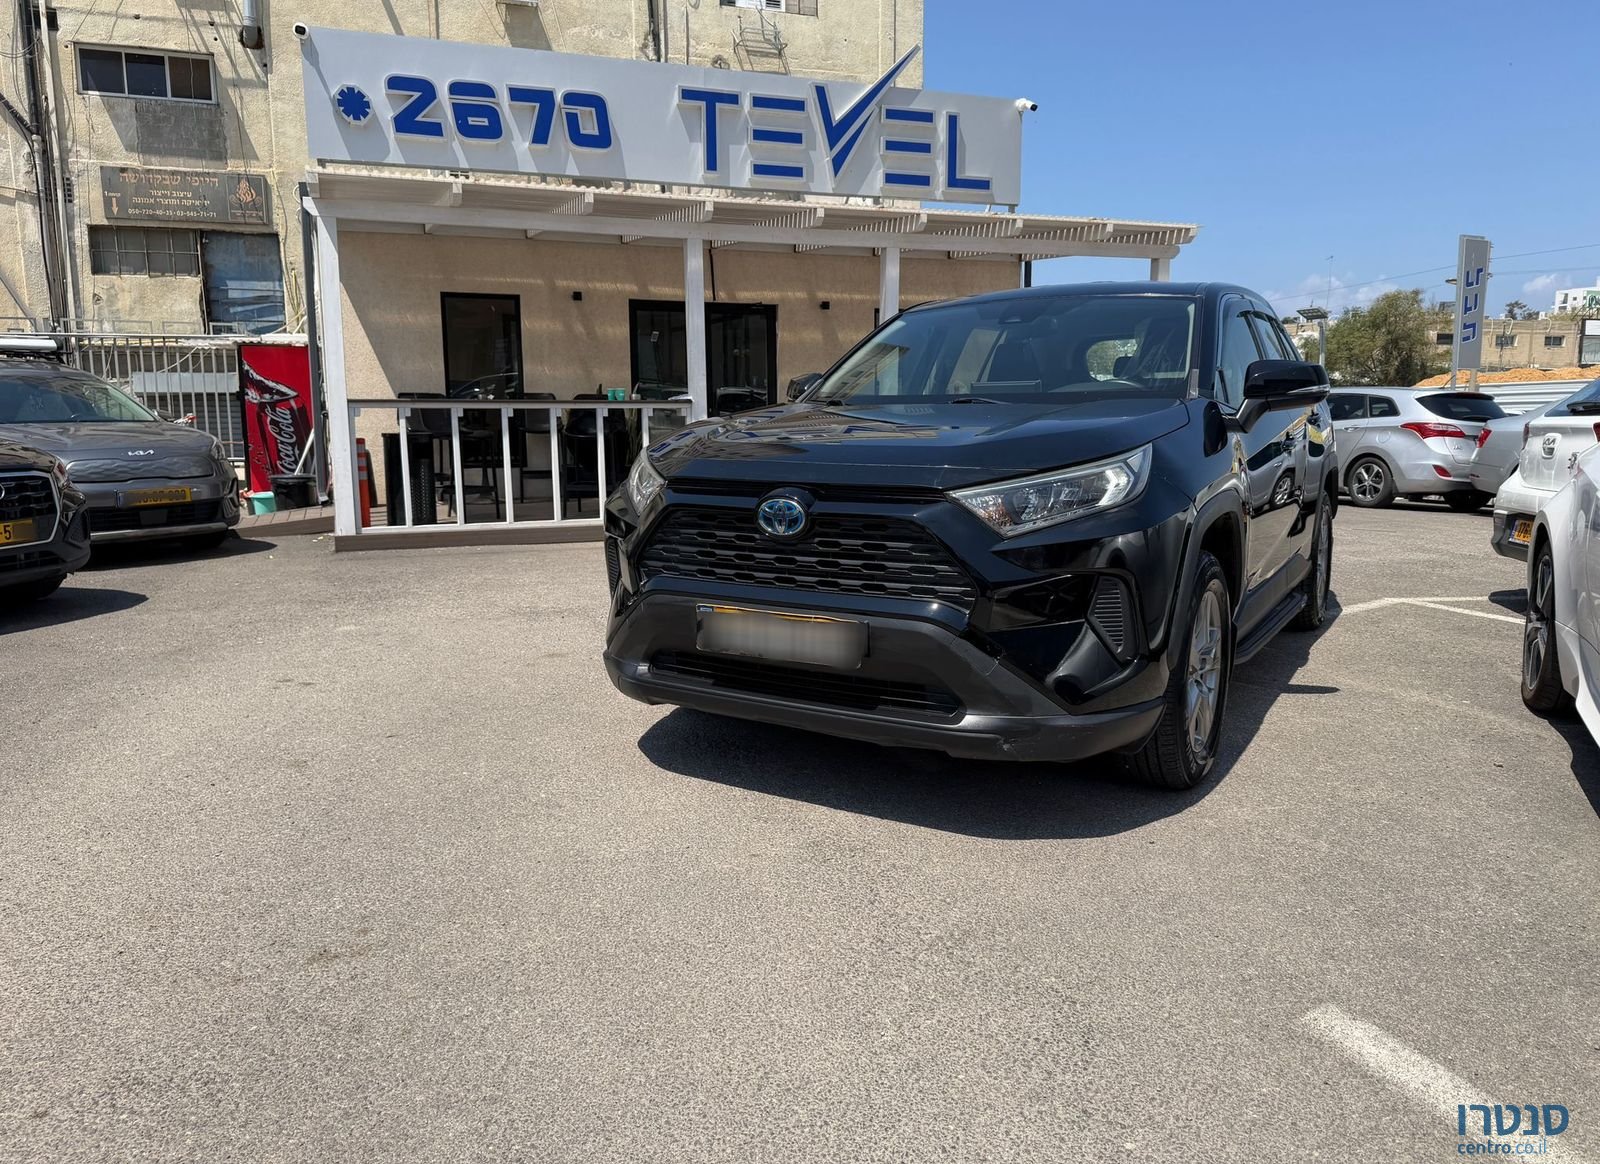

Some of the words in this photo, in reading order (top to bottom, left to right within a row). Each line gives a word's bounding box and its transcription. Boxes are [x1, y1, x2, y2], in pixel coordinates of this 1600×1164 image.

[681, 44, 991, 191] TEVEL
[171, 190, 192, 198] עיצוב
[132, 196, 155, 204] אמונה
[181, 199, 210, 207] יואיקה
